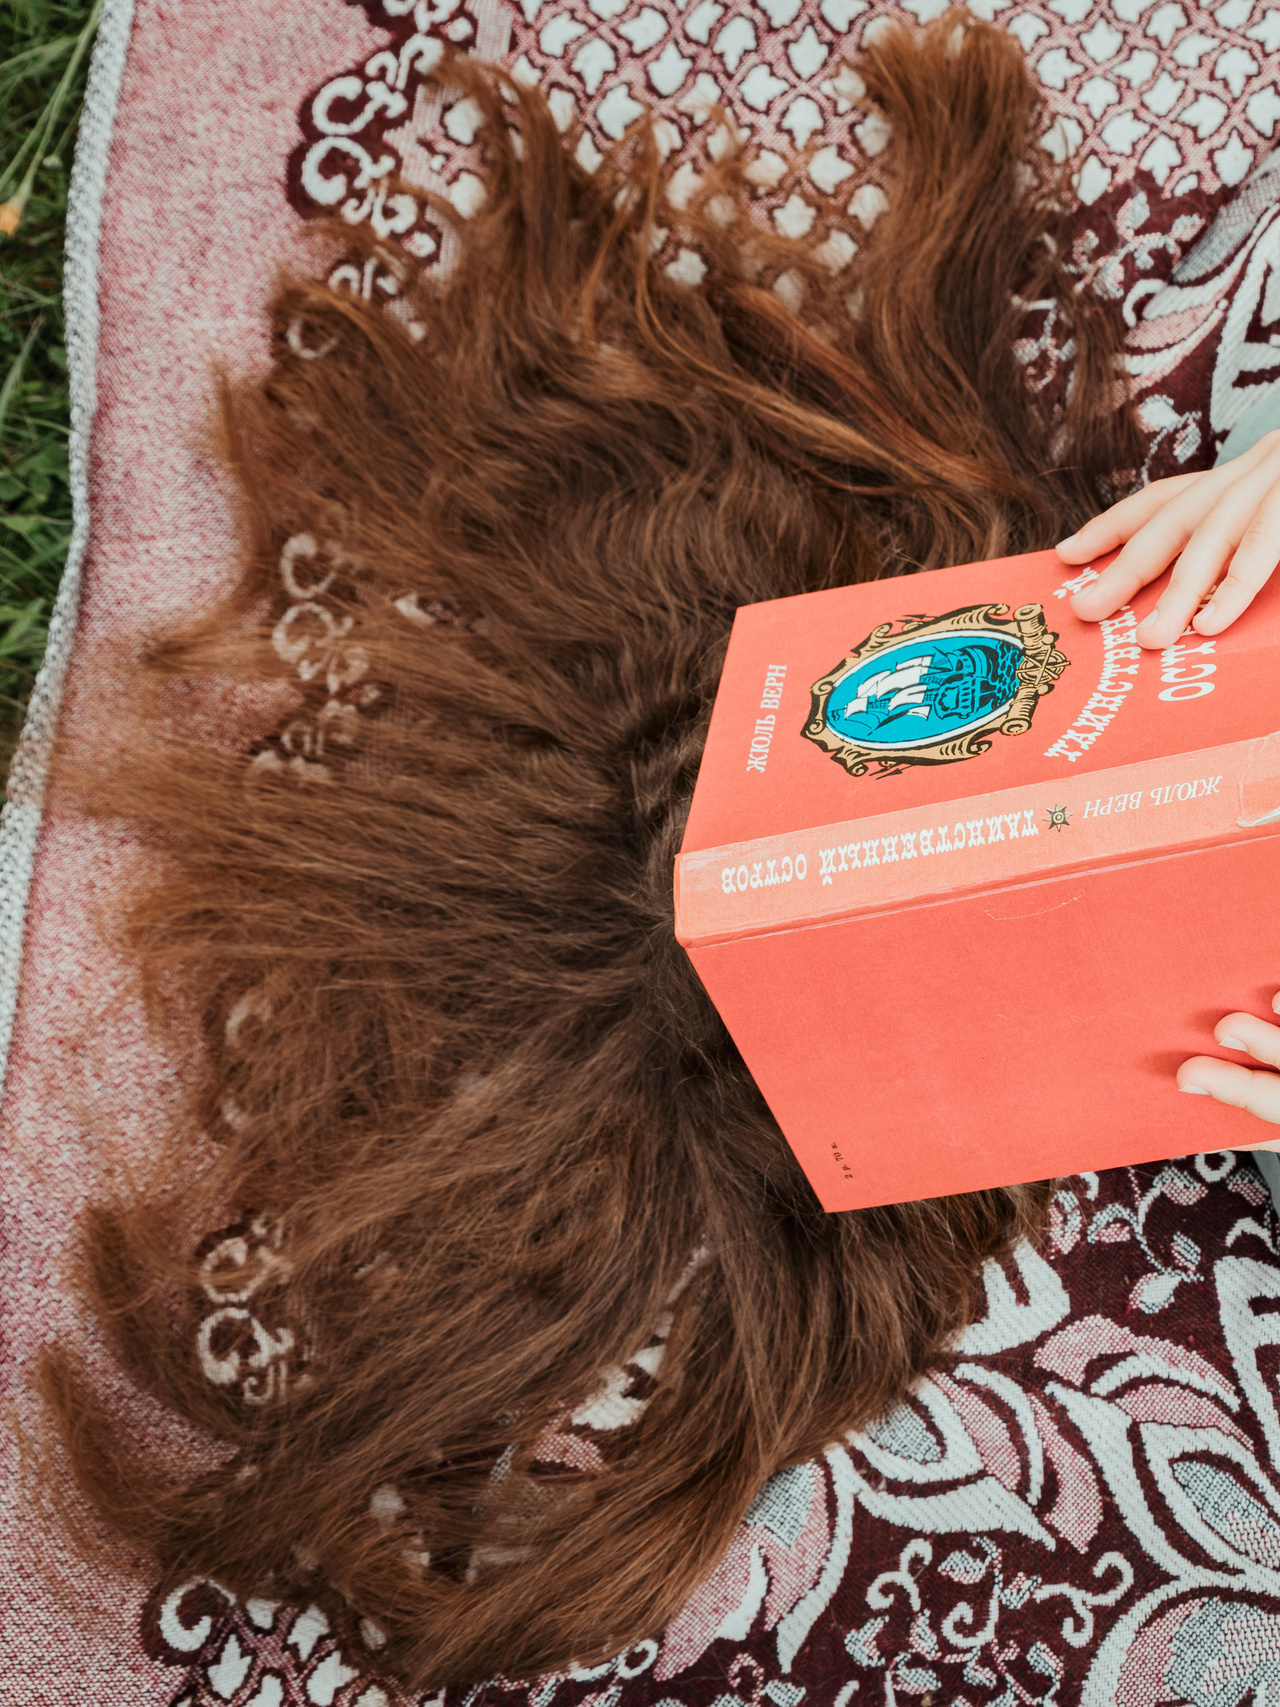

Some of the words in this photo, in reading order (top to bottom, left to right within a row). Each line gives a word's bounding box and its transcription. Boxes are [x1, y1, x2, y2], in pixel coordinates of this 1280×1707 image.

[760, 664, 787, 710] ВЕРН
[1043, 566, 1141, 763] ТАИНСТВЕНЙ
[745, 714, 776, 773] ЖЮЛЬ
[1082, 790, 1144, 819] ВЕРН
[1149, 774, 1224, 806] ЖЮЛЬ
[818, 808, 1040, 886] ТАИНСТВЕННЫЙ
[720, 852, 808, 895] ОСТРОВ
